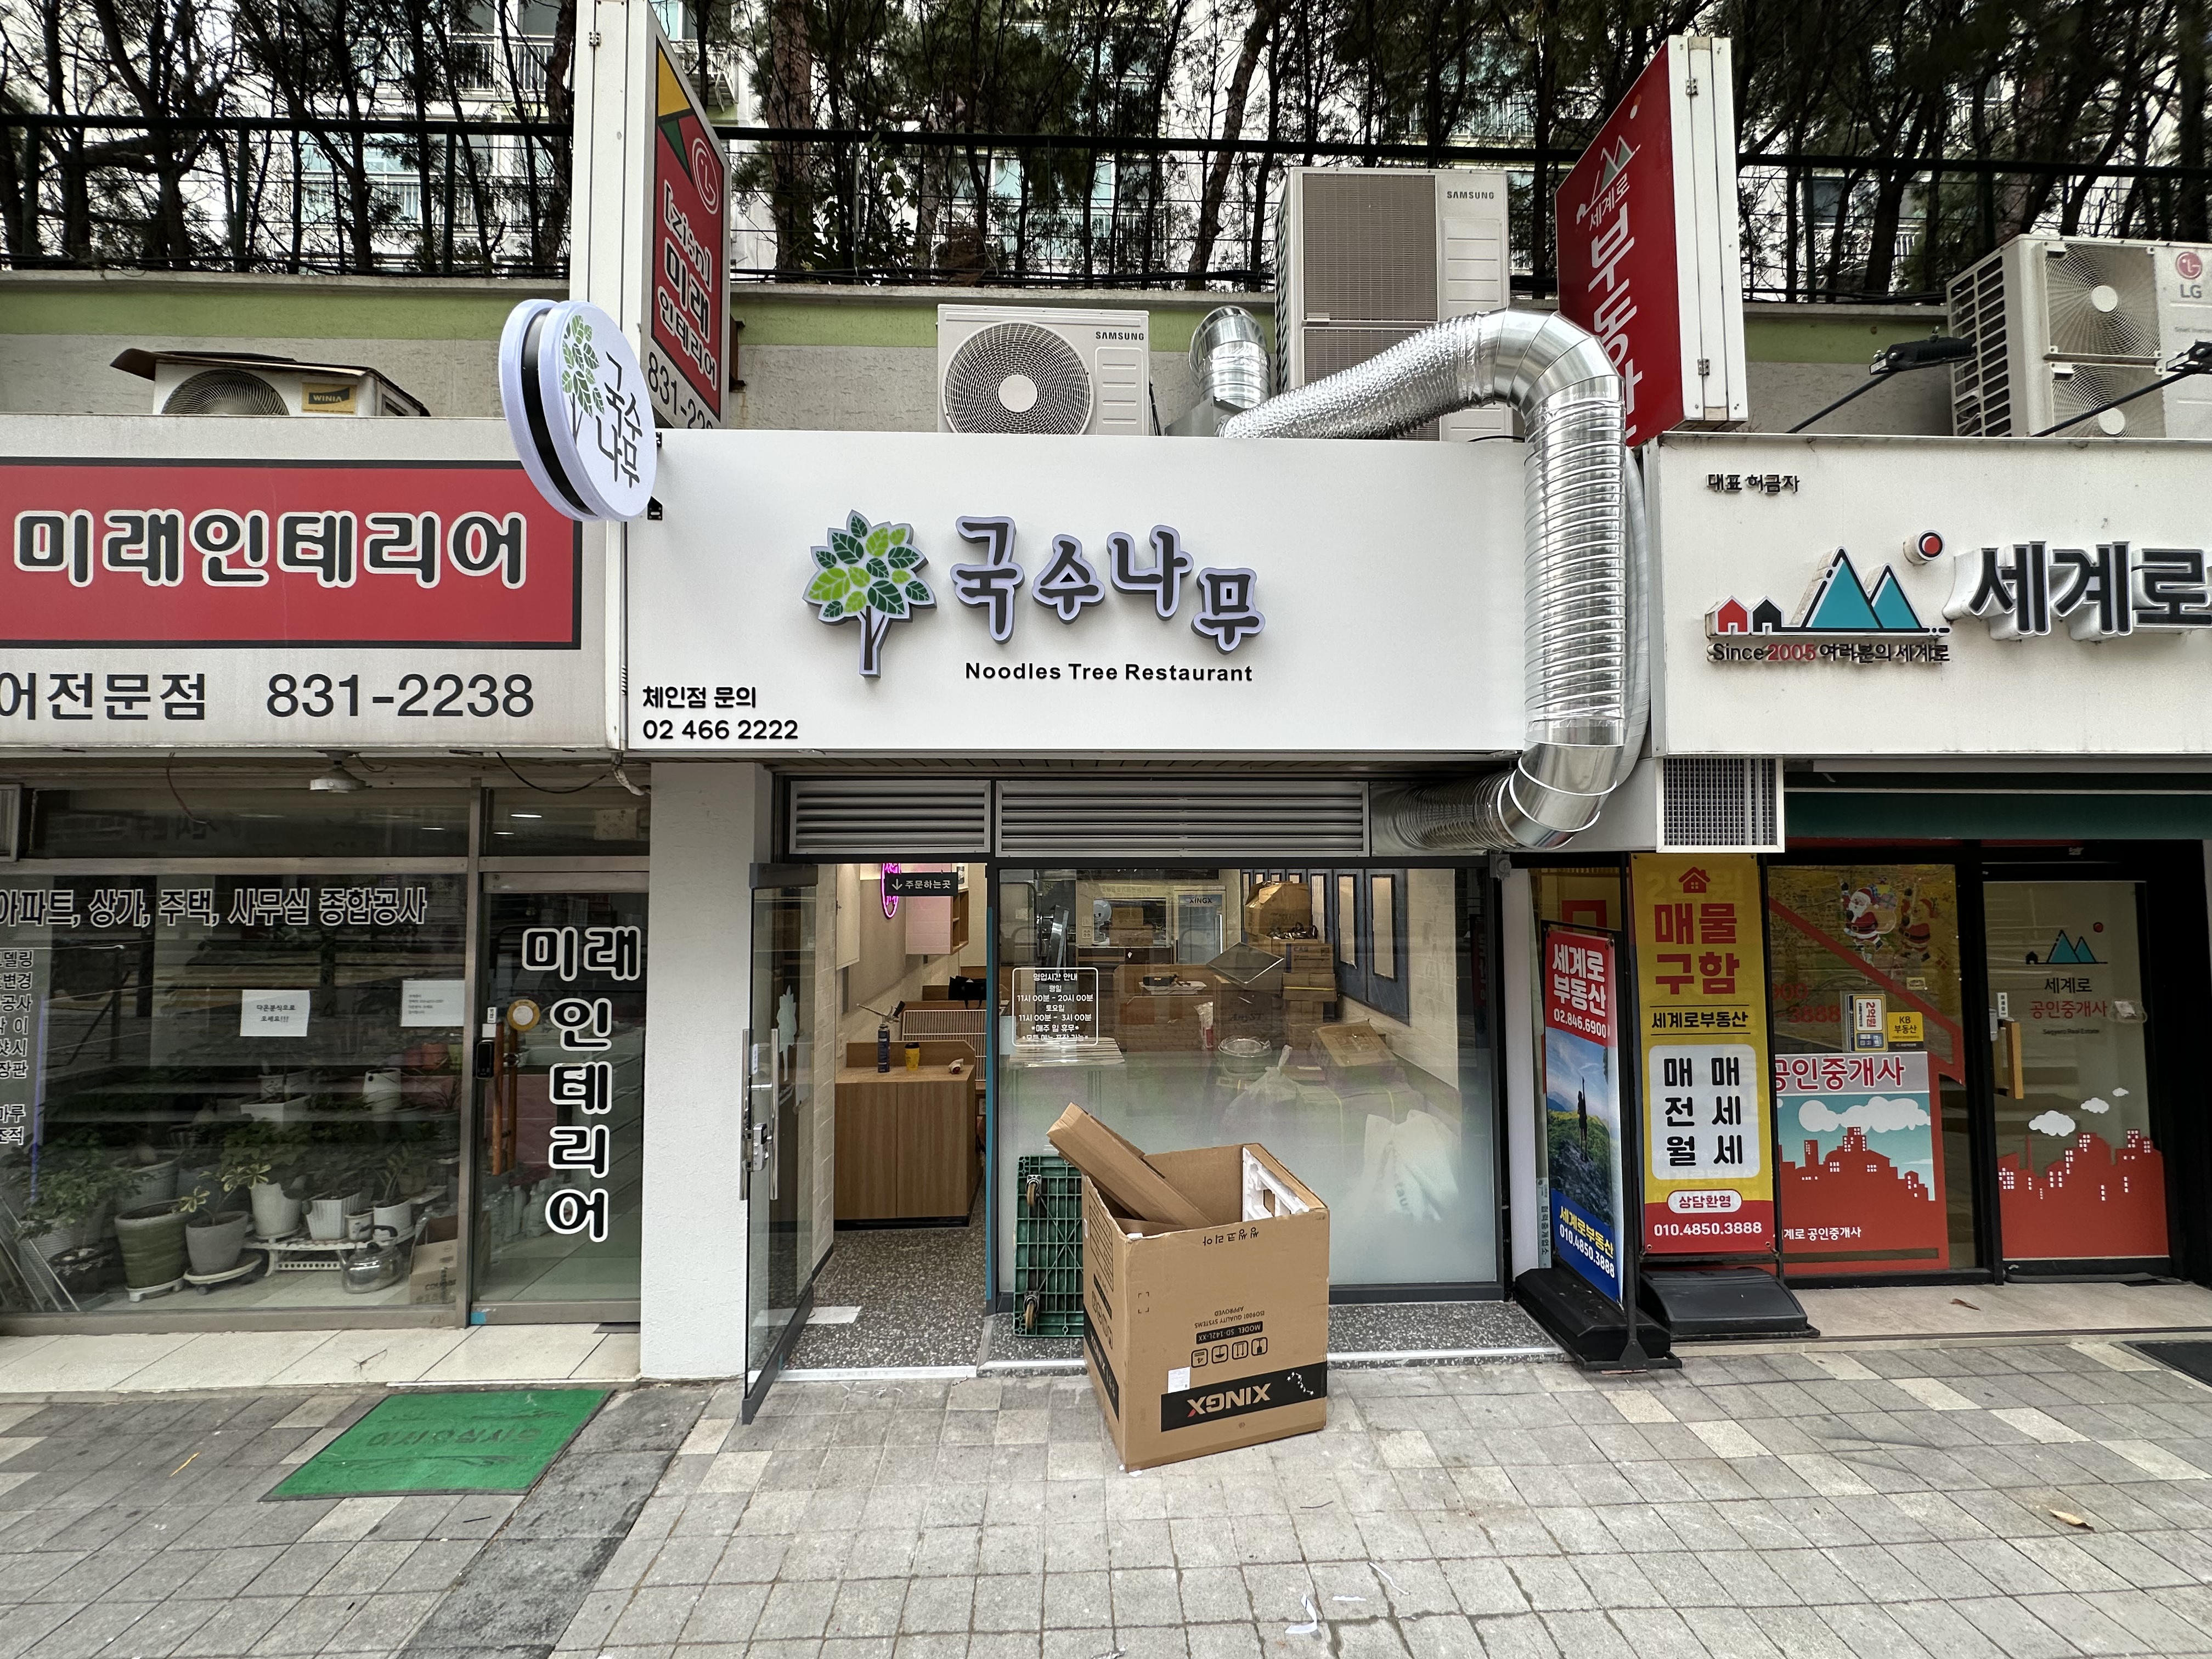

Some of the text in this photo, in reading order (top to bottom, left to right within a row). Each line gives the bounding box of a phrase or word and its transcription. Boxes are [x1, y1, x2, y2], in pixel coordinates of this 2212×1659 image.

[1447, 191, 1494, 199] SAMSUNG
[1589, 172, 1630, 232] 세계로
[664, 236, 711, 344] 미래
[2180, 284, 2202, 298] LG
[1588, 201, 1644, 440] 부동
[657, 285, 717, 391] 인테리어
[1096, 331, 1144, 341] SAMSUNG
[648, 352, 713, 428] 831-22
[1706, 474, 1800, 494] 대표 허금자
[14, 509, 529, 589] 미래인테리어
[950, 516, 1266, 655] 국수나무
[1968, 543, 2212, 636] 세계로
[1709, 643, 1764, 661] Since
[1767, 644, 1816, 661] 2005
[1895, 644, 1950, 663] 세계로
[965, 662, 1253, 681] Noodles Tree Restaurant
[0, 673, 534, 720] 어전문점 831-2238
[642, 685, 757, 709] 체인점 문의
[642, 719, 798, 740] 02 466 2222
[905, 879, 951, 889] 주문하는곳
[0, 887, 427, 928] 아파트, 상가, 주택, 사무실 종합공사
[1654, 902, 1737, 945] 매물
[522, 926, 642, 981] 미래
[1552, 943, 1605, 983] 세계로
[0, 972, 33, 990] 변경
[1033, 973, 1078, 981] 영업시간 안내
[1655, 951, 1740, 995] 구함
[1048, 985, 1062, 993] 평일
[1553, 973, 1606, 1017] 부동산
[2044, 977, 2092, 994] 세계로
[1017, 994, 1031, 1002] 11시
[1032, 994, 1050, 1002] 00분
[1057, 994, 1074, 1002] 20시
[1076, 994, 1094, 1002] 00분
[1045, 1004, 1065, 1012] 토요일
[1018, 1014, 1032, 1022] 11시
[1034, 1013, 1052, 1022] 00분
[1061, 1014, 1073, 1022] 3시
[1866, 1002, 1877, 1028] 2억원
[1899, 1015, 1911, 1024] KB
[2030, 1000, 2108, 1019] 공인중개사
[1052, 1024, 1059, 1032] 일
[1553, 1008, 1607, 1039] 02.846.6900
[1651, 1011, 1749, 1029] 세계로부동산
[1893, 1024, 1917, 1034] 부동산
[1775, 1055, 1905, 1092] 공인중개사
[545, 997, 613, 1243] 인테리어
[1678, 1195, 1731, 1209] 상담환영
[1559, 1206, 1614, 1260] 세계로부동산
[1654, 1222, 1763, 1237] 010.4850.3888
[1781, 1227, 1862, 1242] 계로 공인중개사
[1559, 1223, 1615, 1279] 010.4850.3888
[1194, 1310, 1265, 1329] ISO9001 QUALITY SYSTEMS
[1214, 1306, 1244, 1317] APPROVED
[1198, 1323, 1261, 1342] MODEL SD-142L-XX
[1187, 1383, 1272, 1418] XINGX
